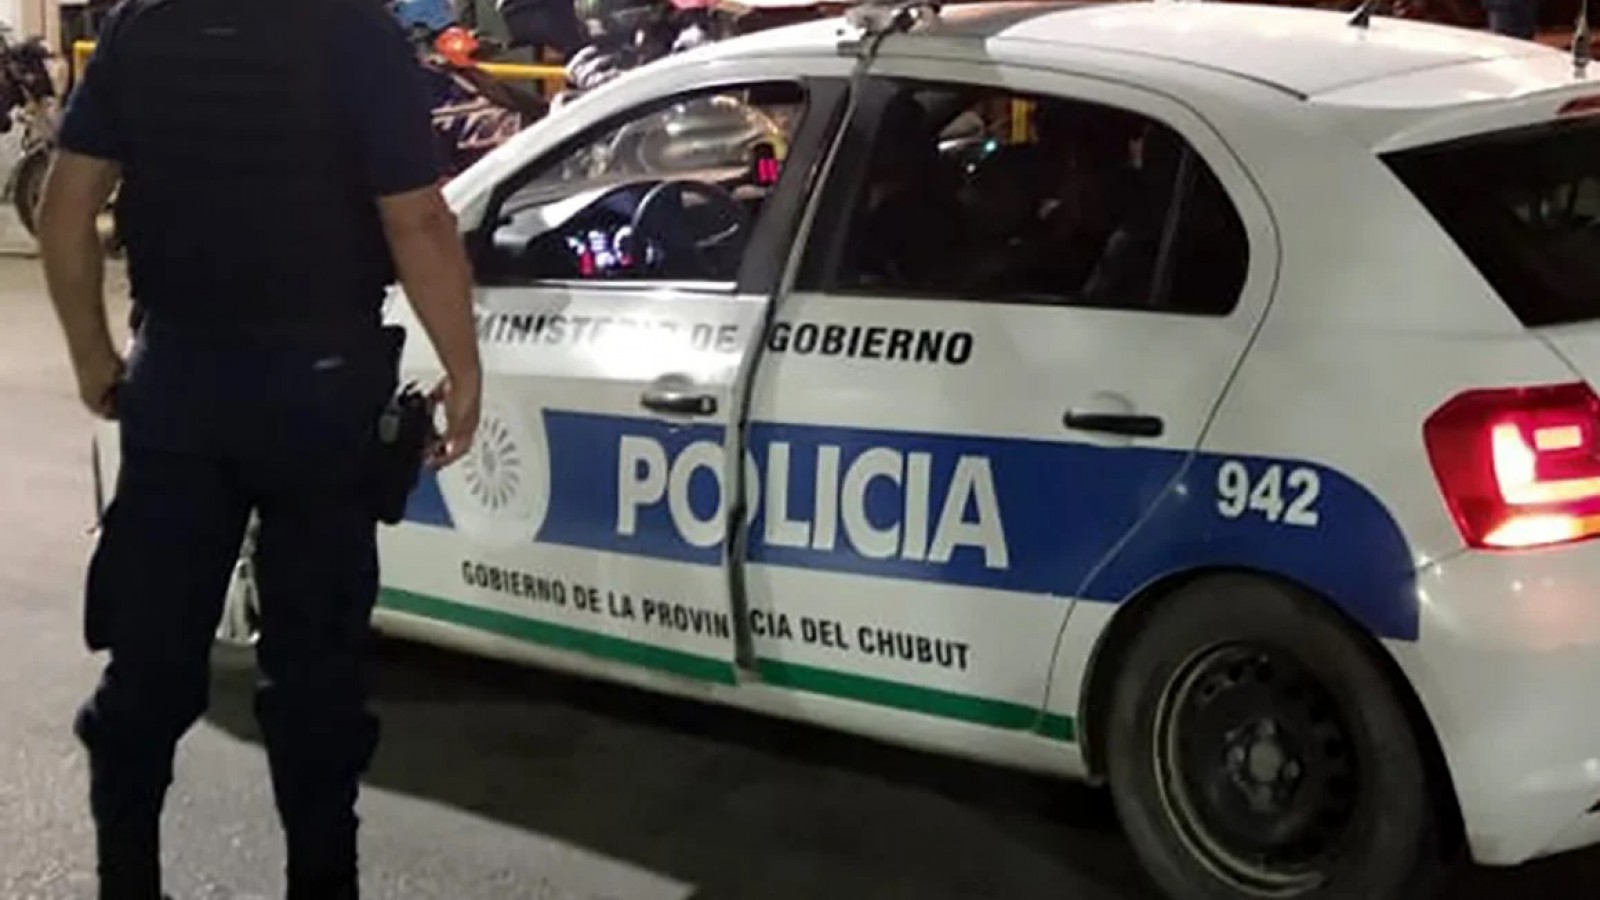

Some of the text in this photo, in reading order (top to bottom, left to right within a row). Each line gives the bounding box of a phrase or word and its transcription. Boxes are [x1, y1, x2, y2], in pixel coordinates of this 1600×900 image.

[477, 313, 974, 366] MINIST DE GOBIERNO
[616, 434, 1010, 569] POLICIA
[1218, 460, 1320, 527] 942
[461, 560, 970, 672] GOBIERNO DE LA PROVINCIA DEL CHUBUT
